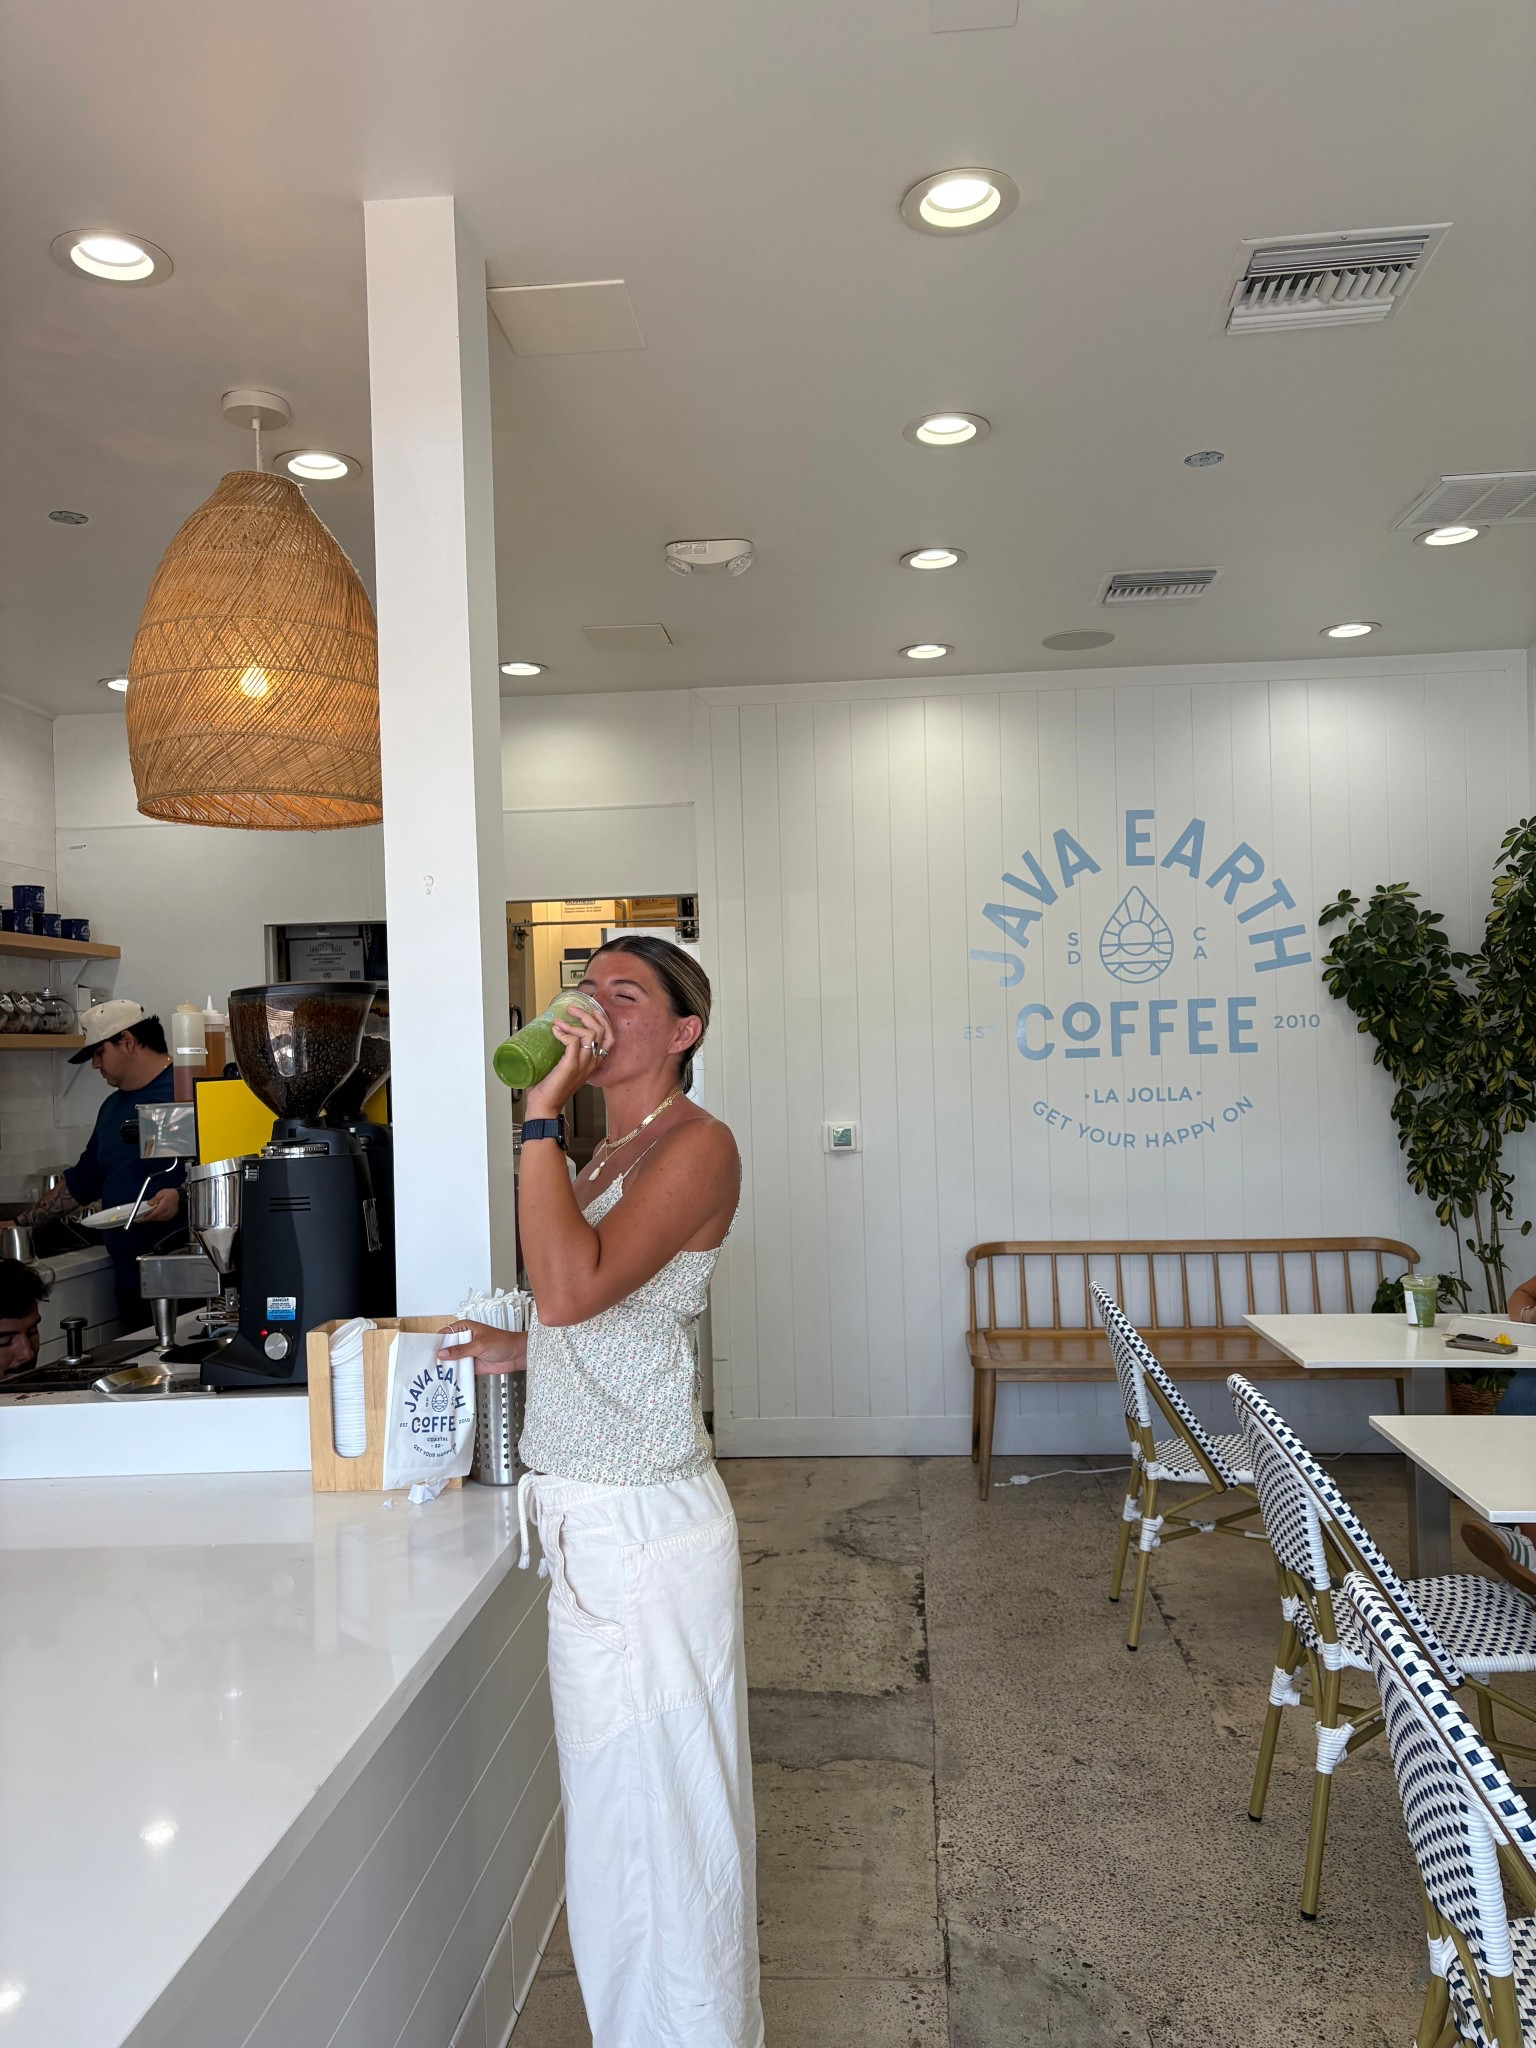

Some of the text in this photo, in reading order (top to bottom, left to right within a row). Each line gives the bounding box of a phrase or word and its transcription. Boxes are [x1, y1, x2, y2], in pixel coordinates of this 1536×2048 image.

[969, 809, 1312, 988] JAVA EARTH
[1016, 997, 1259, 1060] COFFEE
[1274, 1014, 1321, 1029] 2010
[1032, 1095, 1254, 1148] GET YOUR HAPPY ON
[405, 1369, 433, 1412] JAVA
[413, 1444, 423, 1453] GET
